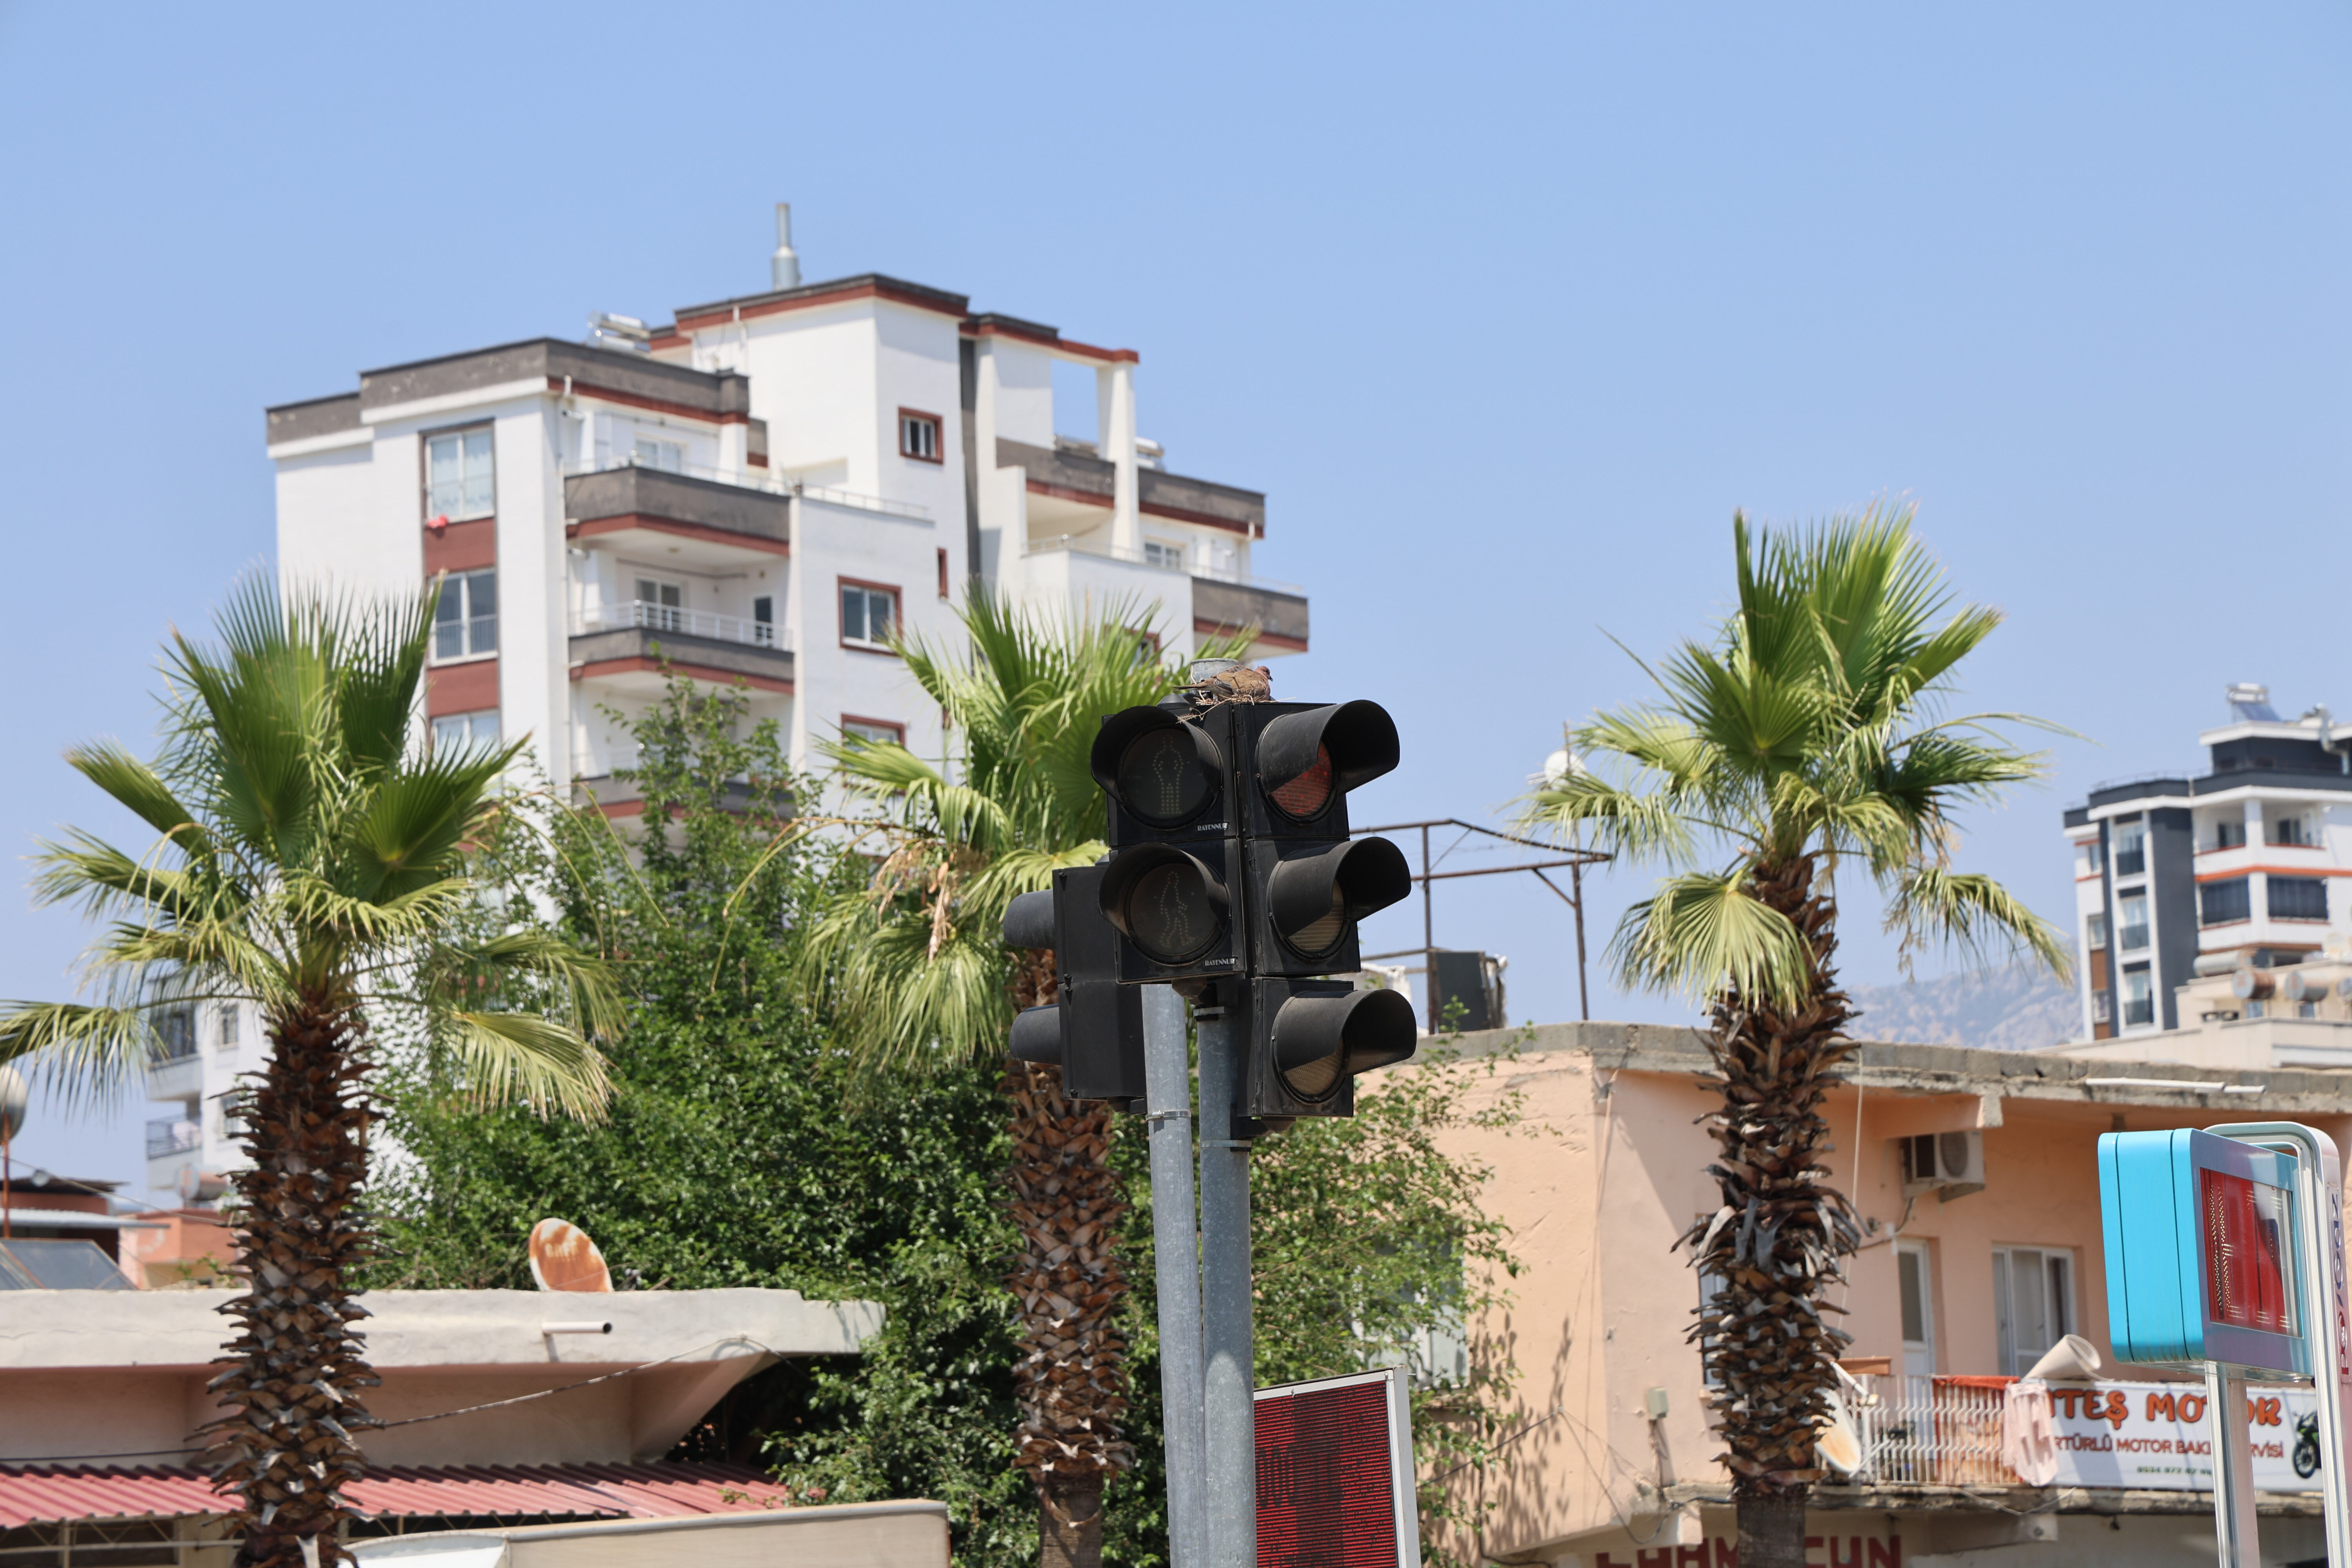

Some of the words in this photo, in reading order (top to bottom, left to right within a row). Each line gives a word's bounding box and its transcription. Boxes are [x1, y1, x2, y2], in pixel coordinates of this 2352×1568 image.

[1197, 822, 1228, 831] RAYENNUR
[1205, 958, 1236, 966] RAYENNUR
[2146, 1392, 2282, 1426] MOR
[2054, 1433, 2112, 1451] RTÜRLÜ
[2116, 1437, 2172, 1453] MOTOR
[2176, 1440, 2211, 1454] BAKI
[2250, 1440, 2283, 1458] RVİSİ
[1597, 1535, 1901, 1568] LAHMCUN
